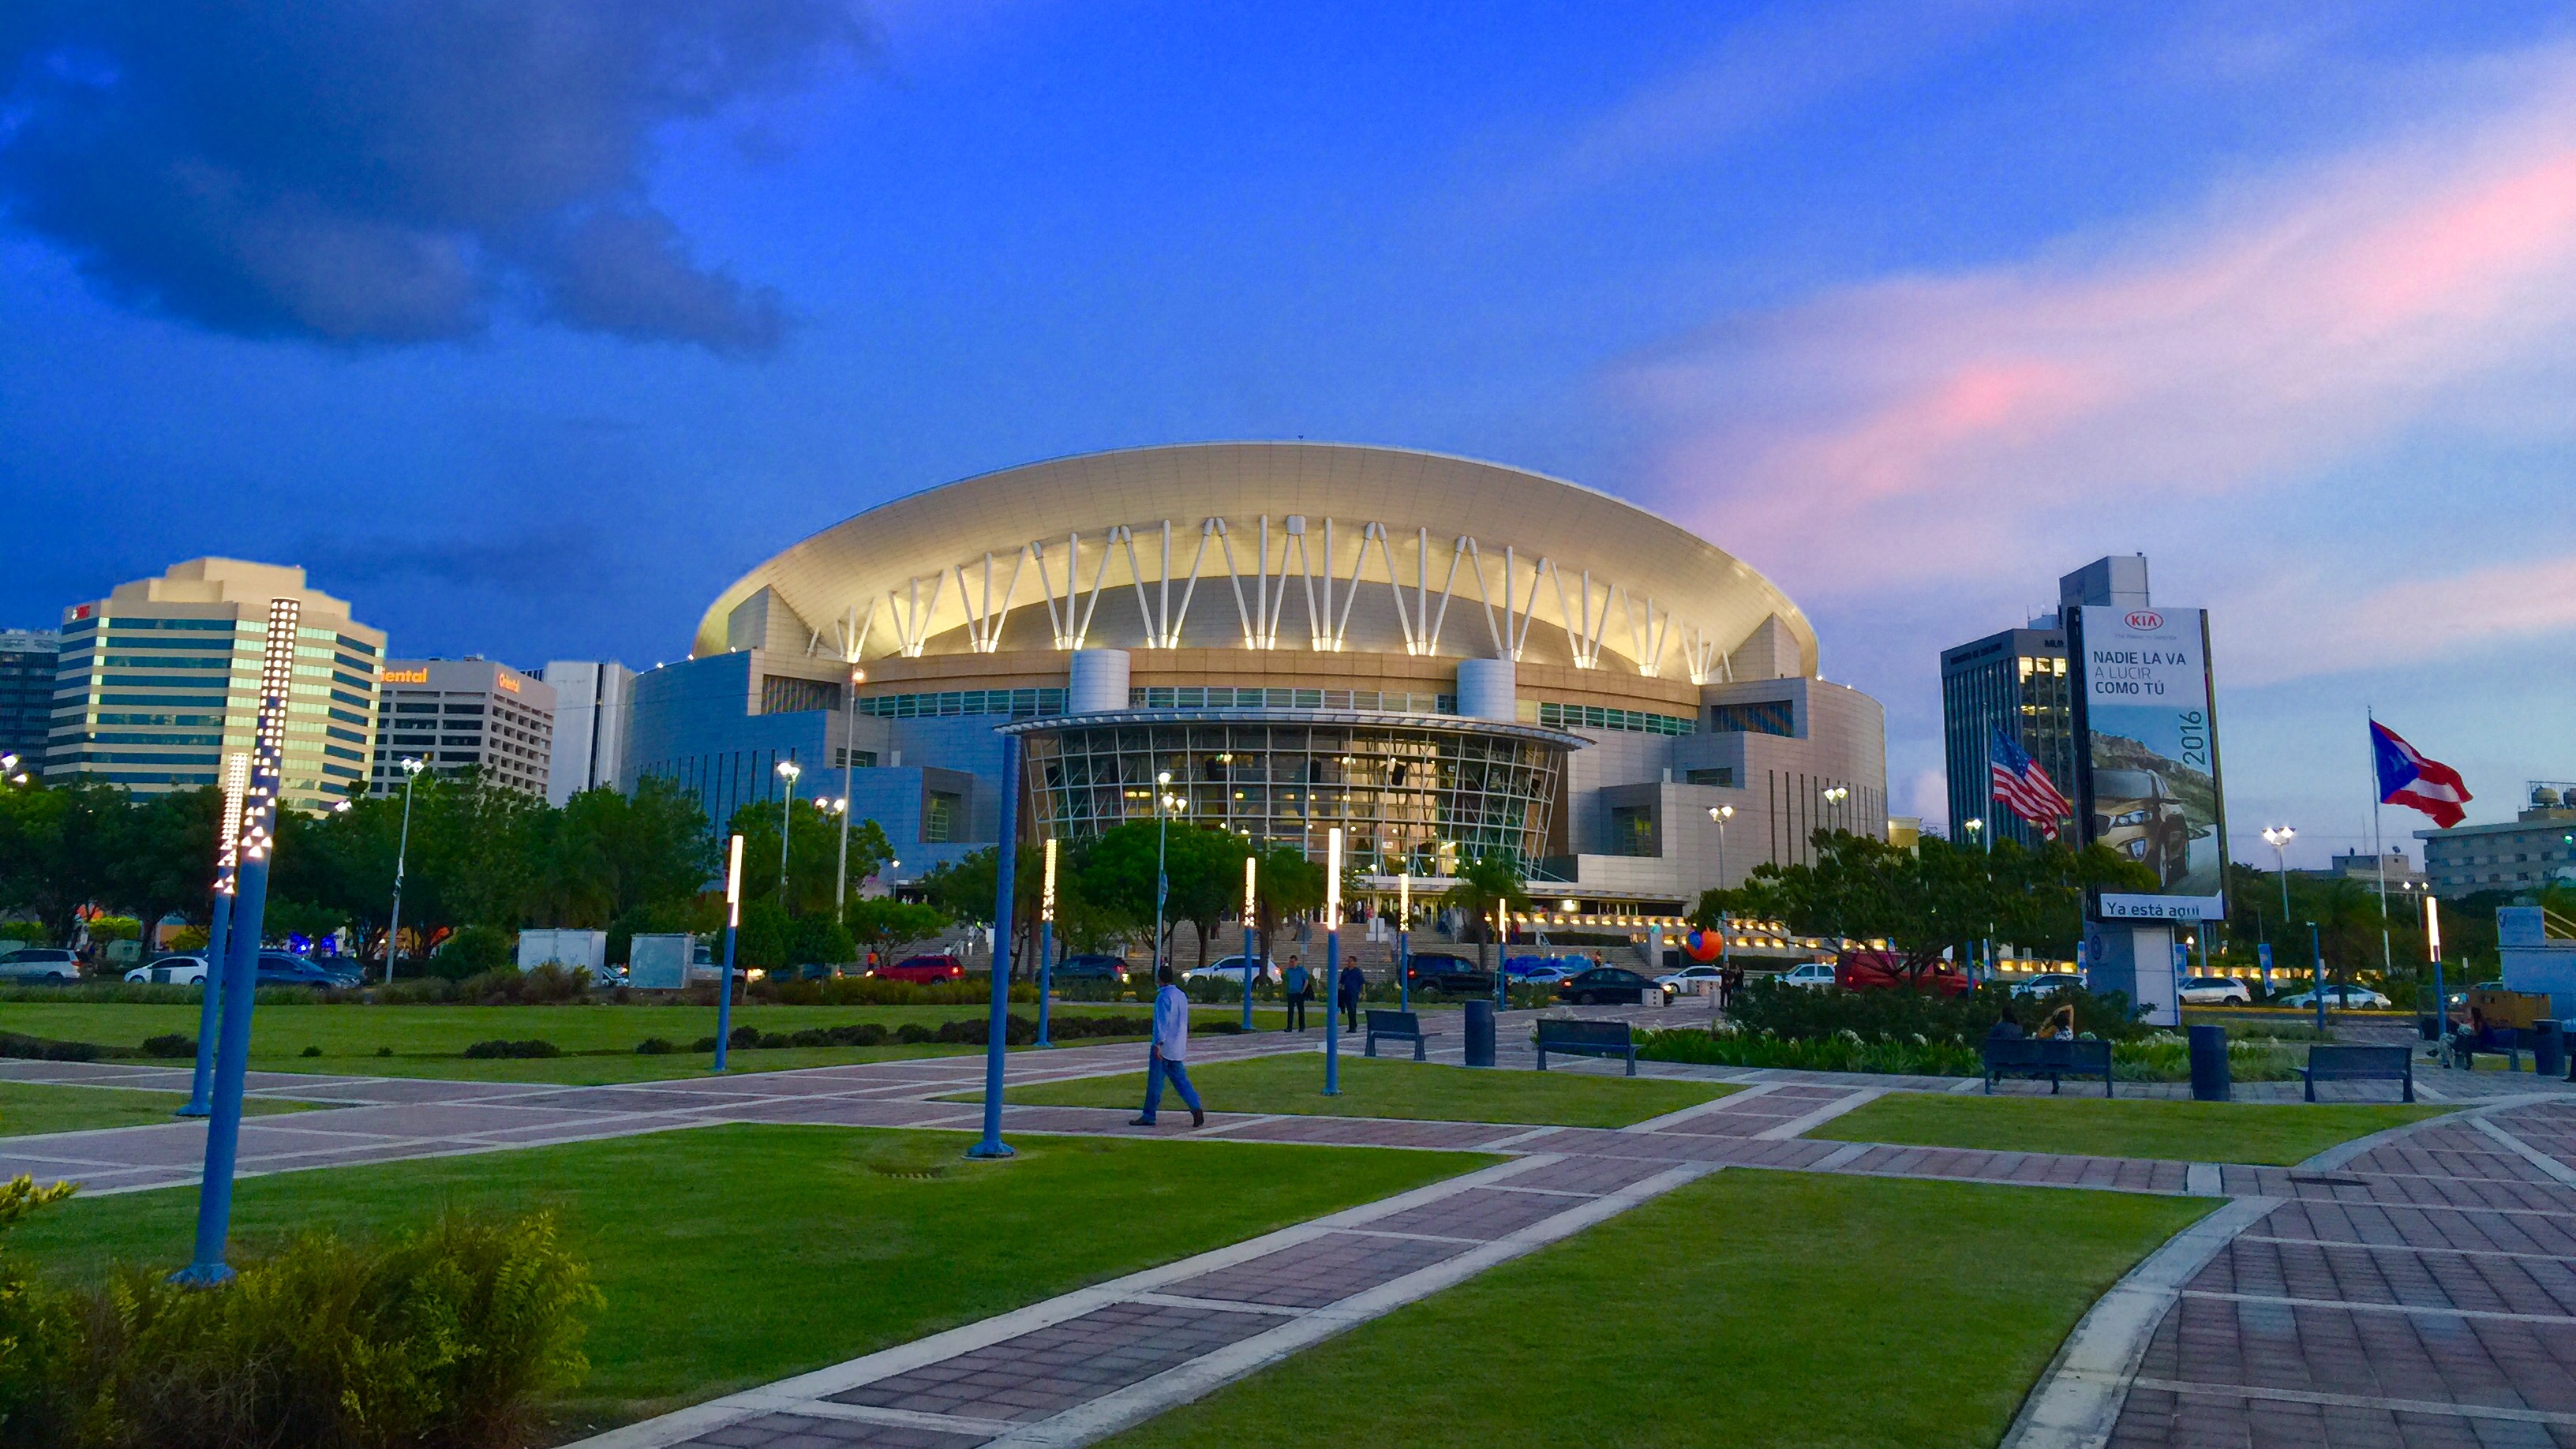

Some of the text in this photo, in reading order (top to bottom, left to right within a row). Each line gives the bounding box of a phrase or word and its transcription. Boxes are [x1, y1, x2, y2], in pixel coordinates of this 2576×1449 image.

[2131, 615, 2158, 627] KIA
[2093, 651, 2187, 665] NADIE LA VA
[381, 668, 428, 683] iental
[2095, 666, 2151, 680] A LUCIR
[2095, 680, 2165, 695] COMO TÚ
[2178, 711, 2206, 766] 2016
[2106, 902, 2200, 918] Ya está aquí
